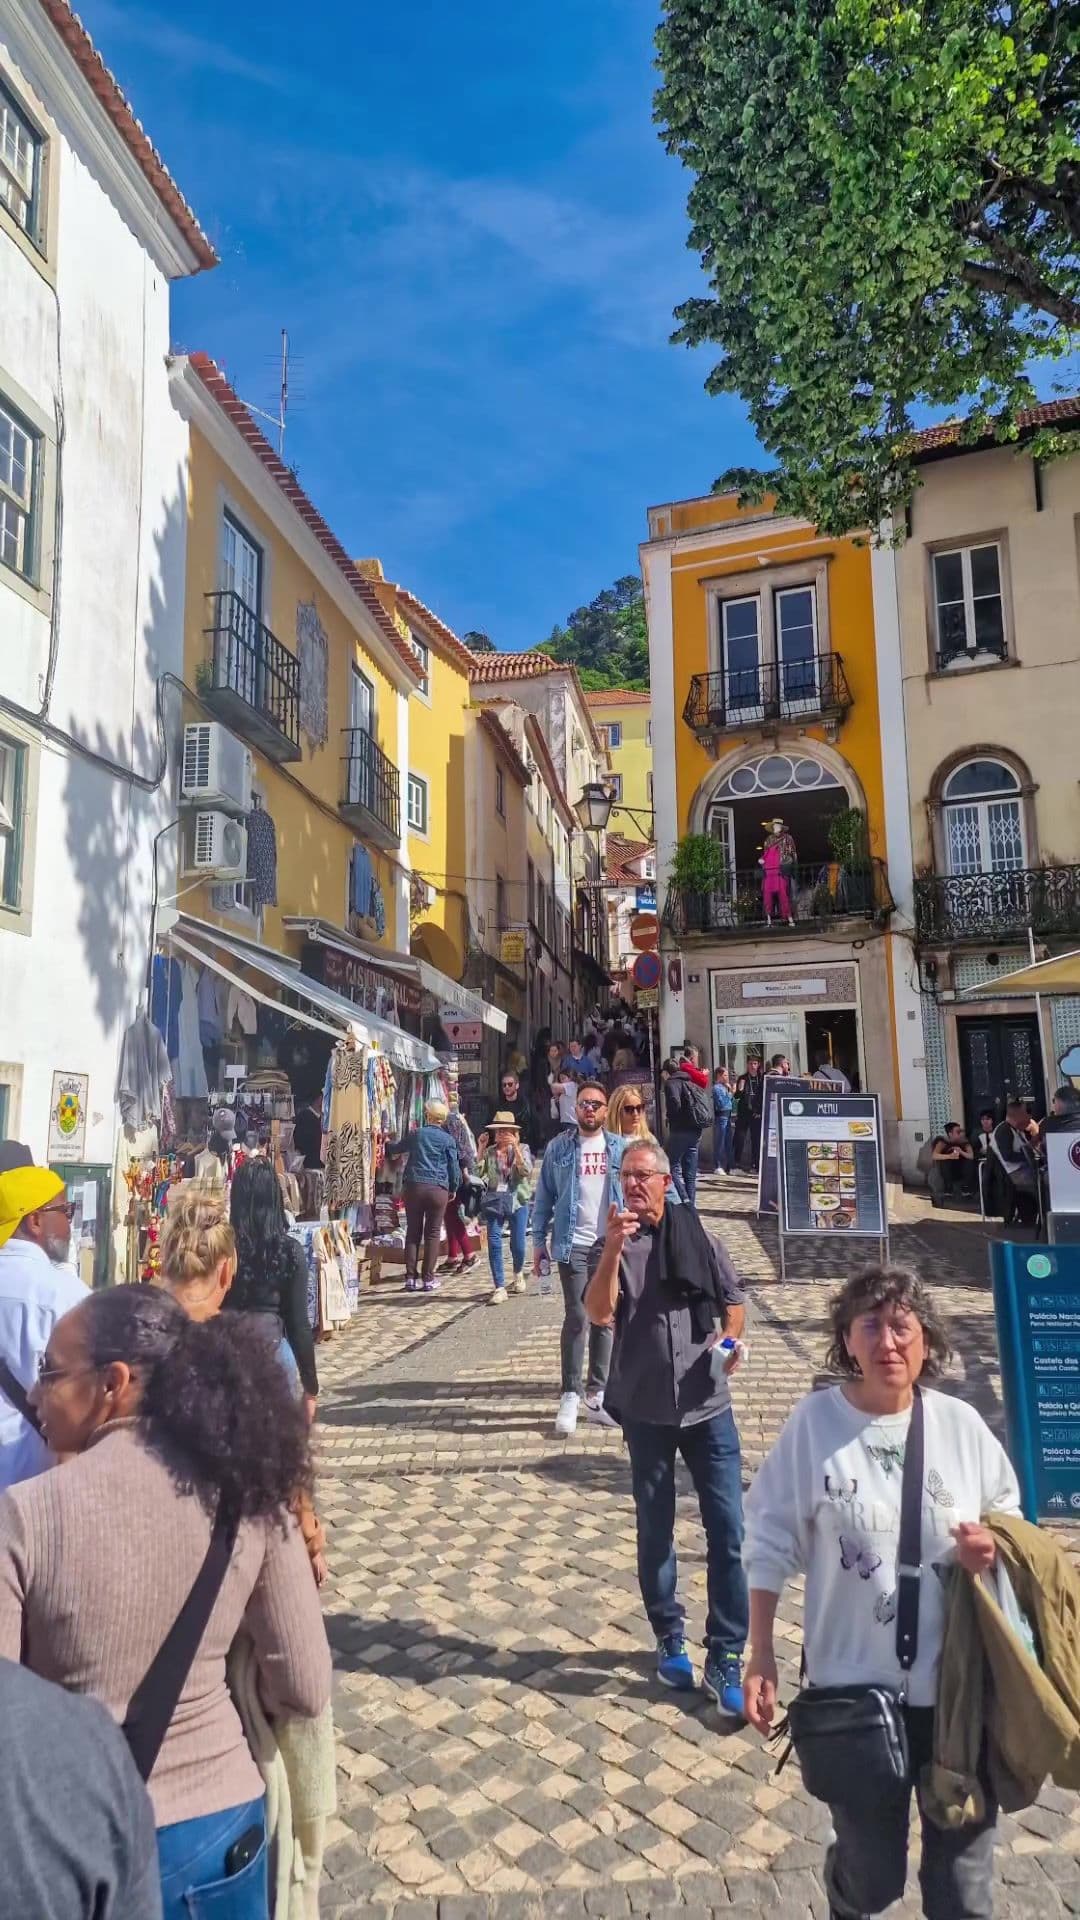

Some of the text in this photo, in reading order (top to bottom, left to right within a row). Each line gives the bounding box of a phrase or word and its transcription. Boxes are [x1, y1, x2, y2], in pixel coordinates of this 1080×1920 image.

[808, 1080, 841, 1092] MENU
[817, 1103, 838, 1114] MENU
[1029, 1312, 1057, 1320] Palácio
[1038, 1401, 1063, 1409] Palácio
[1042, 1447, 1070, 1455] Palácio
